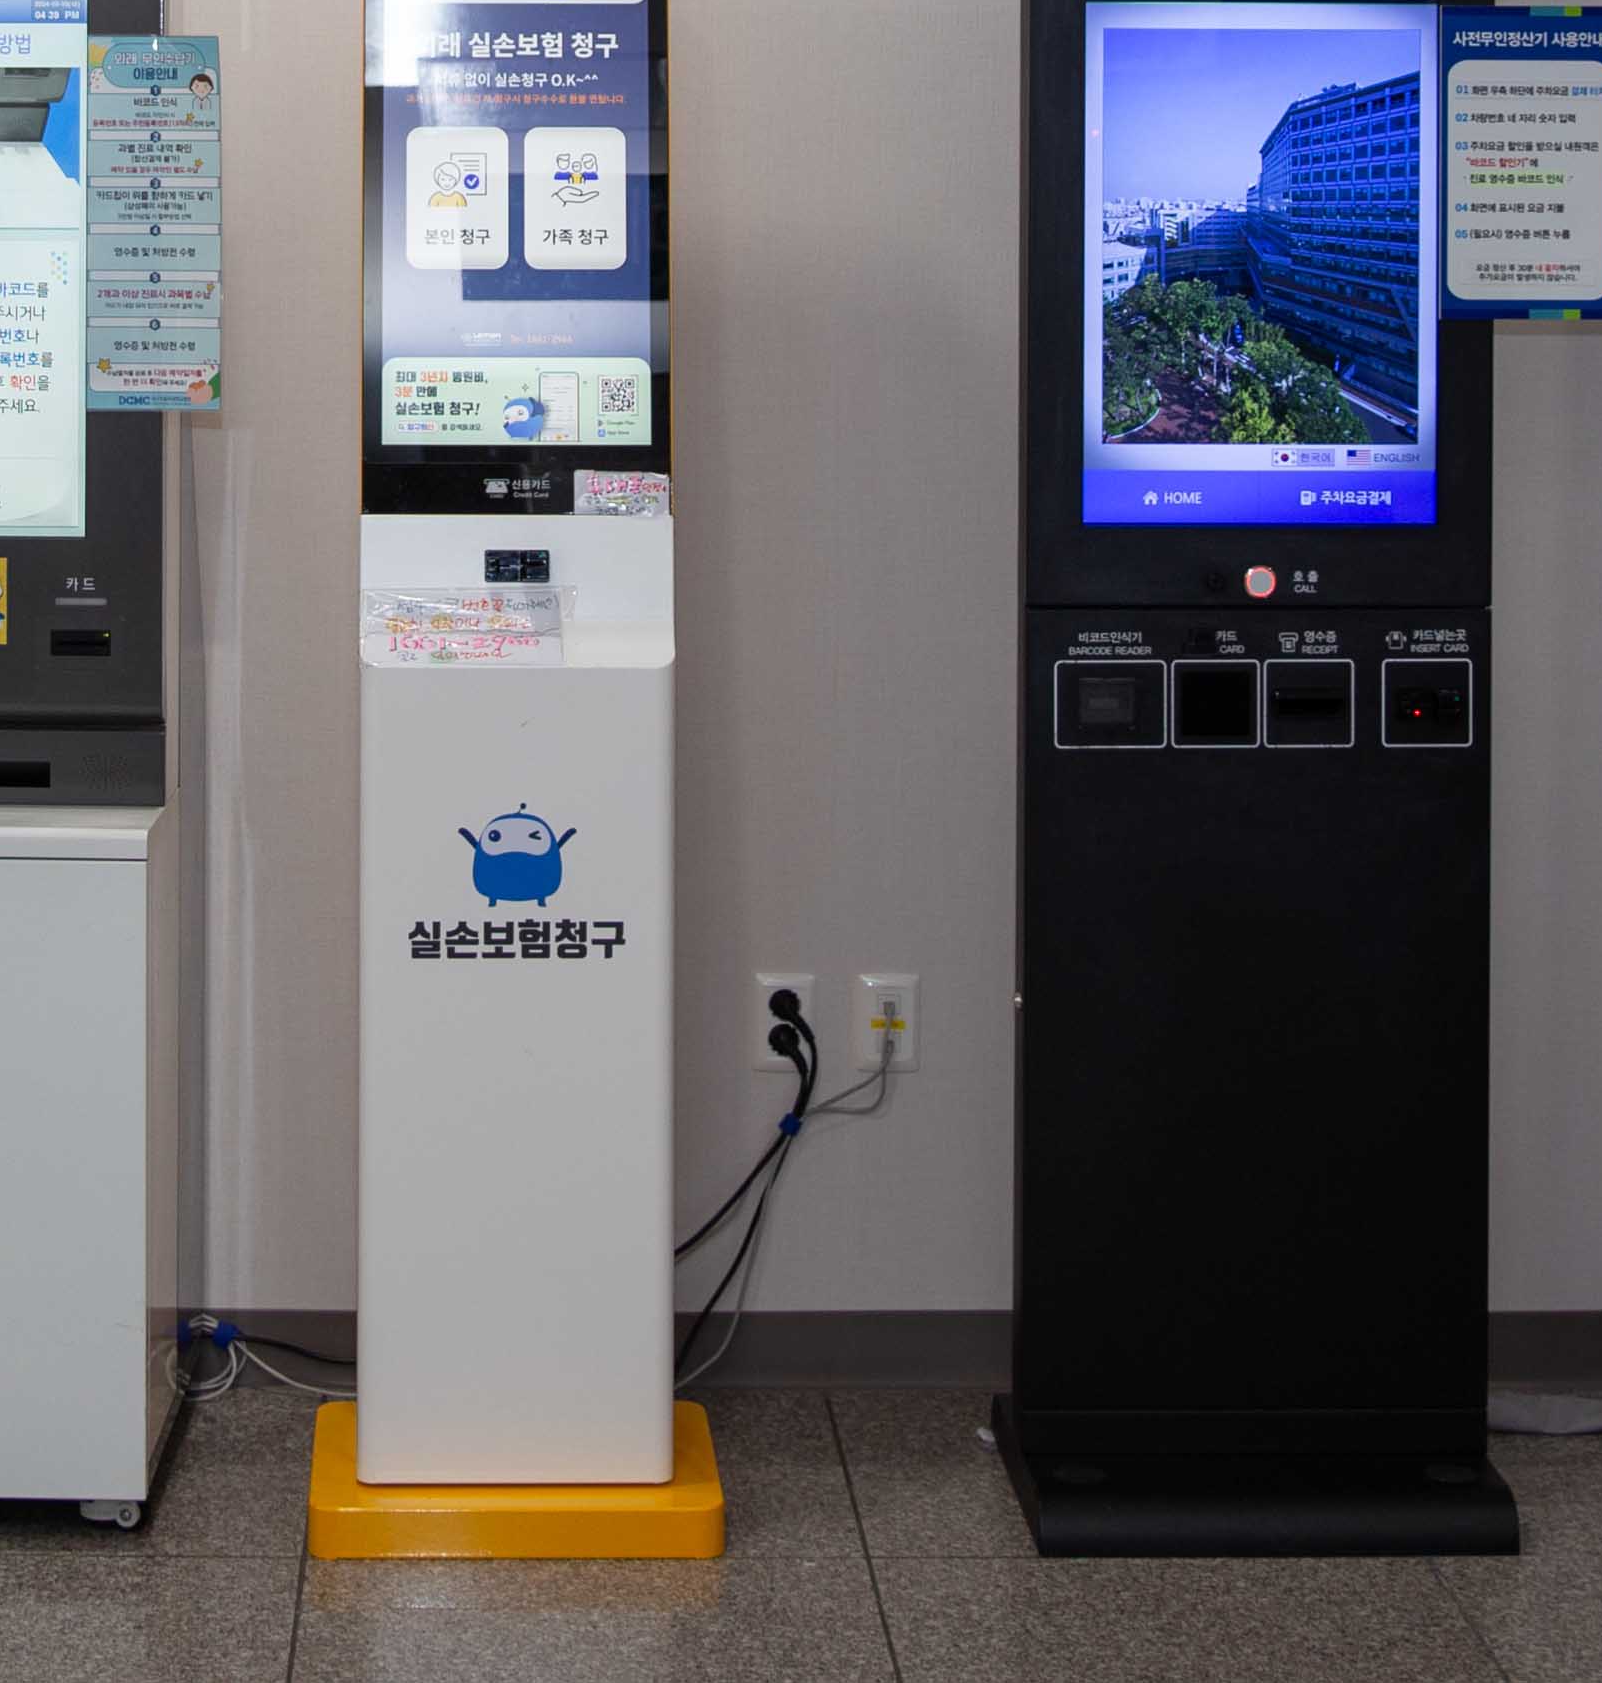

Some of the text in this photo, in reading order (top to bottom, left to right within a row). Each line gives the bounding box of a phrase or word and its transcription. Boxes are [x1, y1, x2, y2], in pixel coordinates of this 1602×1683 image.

[469, 32, 619, 58] 실손보험 청구
[1453, 32, 1547, 48] 사전무인정산기
[464, 73, 547, 87] 없이 실손청구
[425, 228, 491, 245] 본인 청구
[543, 229, 609, 245] 가족 청구
[395, 402, 480, 416] 실손보험 청구!
[1374, 453, 1420, 462] ENGLISH
[512, 478, 550, 490] 신용카드
[1164, 491, 1391, 506] HOME 주차요금결제
[1294, 585, 1316, 594] CALL
[1304, 631, 1336, 643] 영수증
[1069, 647, 1151, 655] BARCODE READER
[1220, 645, 1244, 653] CARD
[1302, 645, 1338, 654] RECEIPT
[1411, 644, 1469, 653] INSERT CARD
[408, 919, 625, 959] 실손보험청구
